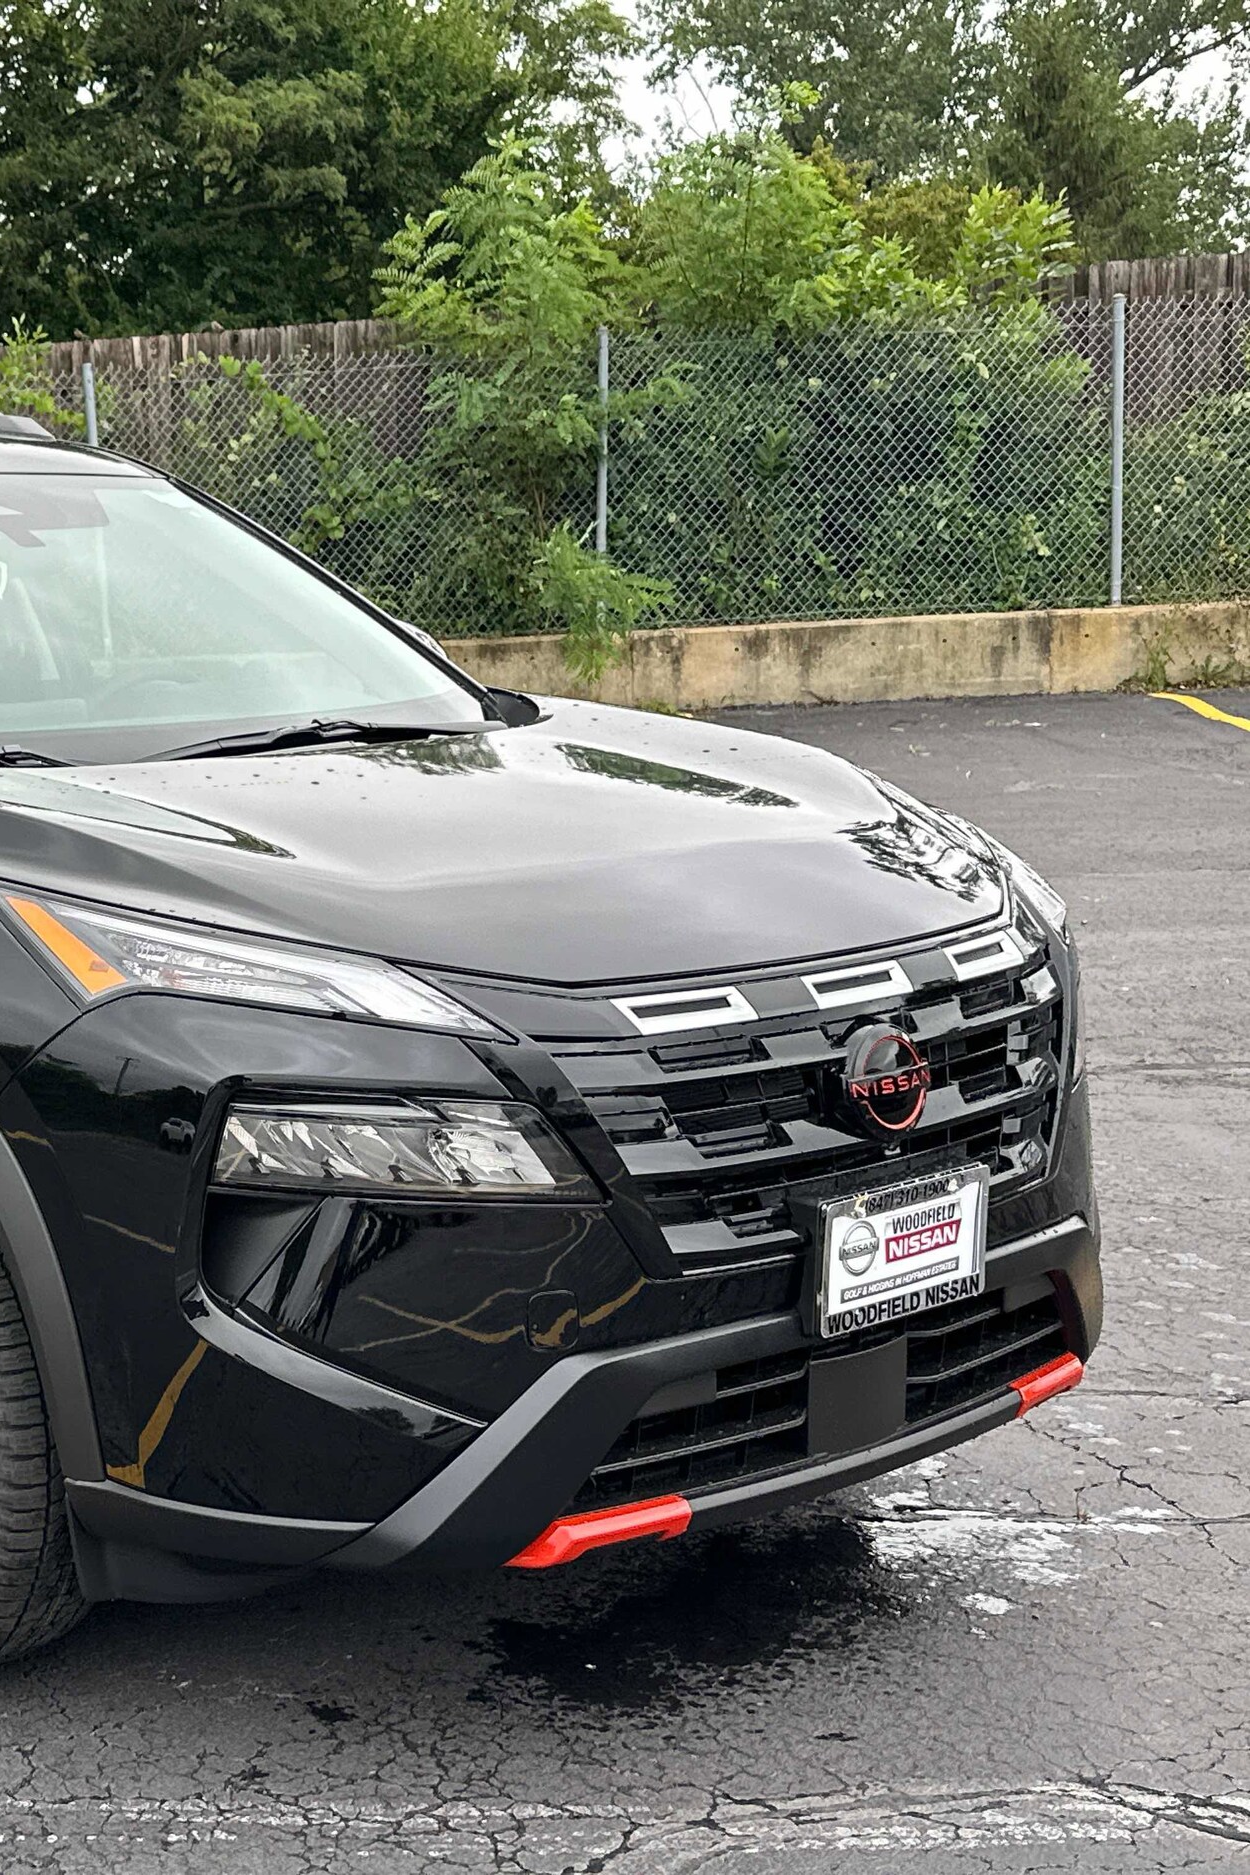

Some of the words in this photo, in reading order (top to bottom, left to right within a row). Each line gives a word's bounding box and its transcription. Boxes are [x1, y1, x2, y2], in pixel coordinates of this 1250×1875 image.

[851, 1069, 931, 1099] NISSAN
[865, 1192, 894, 1212] (847)
[896, 1179, 950, 1205] 310-1900
[892, 1203, 956, 1235] WOODFIELD
[842, 1240, 877, 1256] NISSAN
[888, 1223, 957, 1260] NISSAN
[827, 1292, 921, 1335] WOODFIELD
[925, 1274, 980, 1307] NISSAN
[843, 1288, 862, 1300] GOLF
